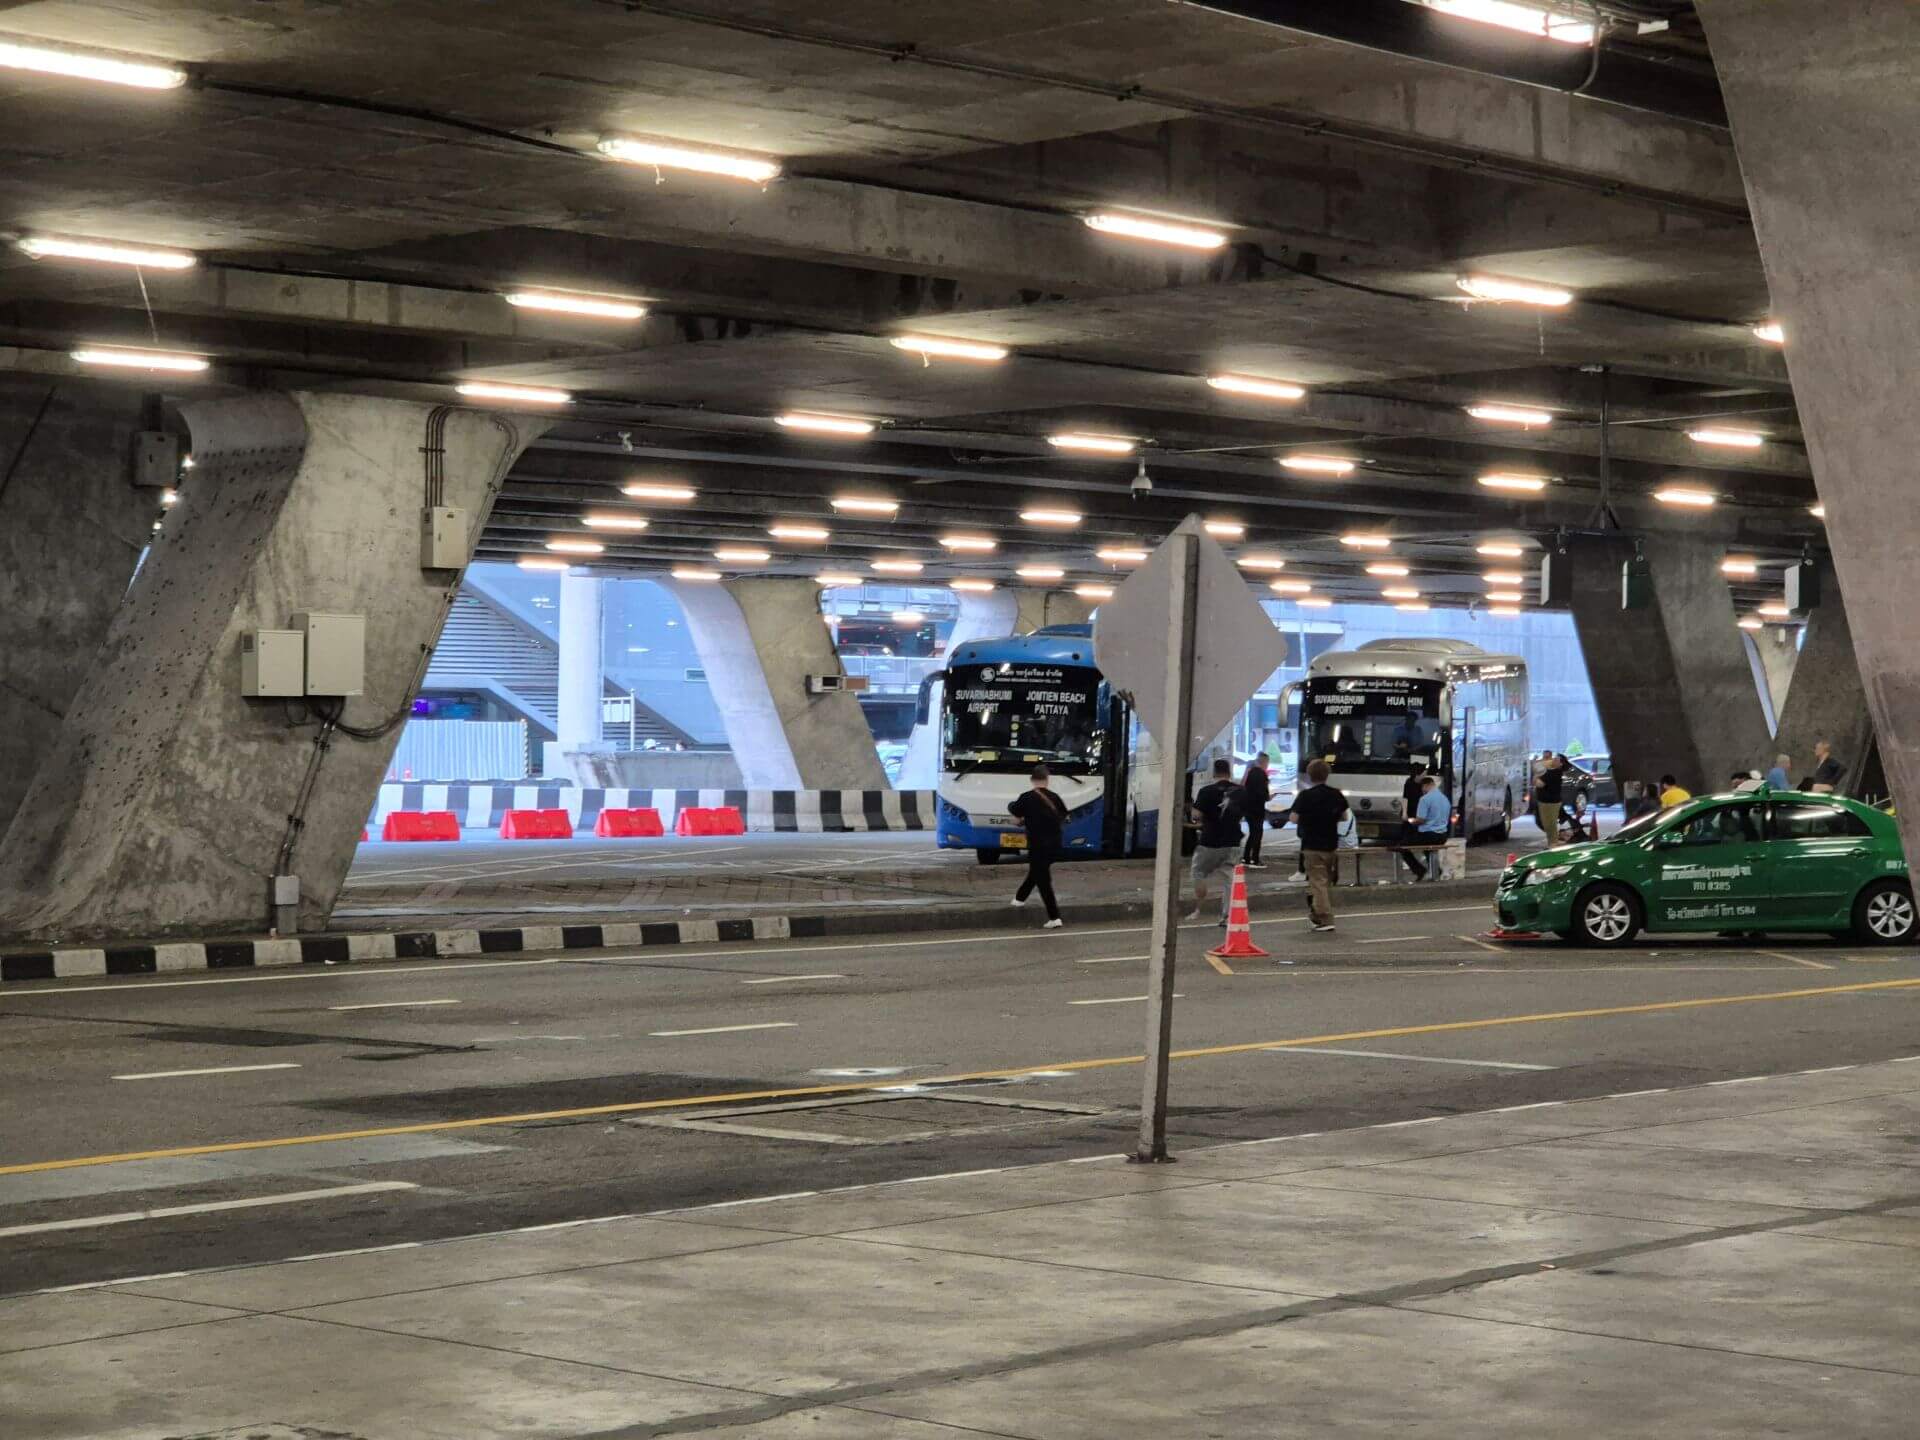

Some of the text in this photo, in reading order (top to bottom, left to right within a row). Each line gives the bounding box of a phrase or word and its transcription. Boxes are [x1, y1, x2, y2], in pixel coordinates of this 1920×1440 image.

[955, 690, 1012, 701] SUVARNABHUMI
[1026, 691, 1086, 704] JOMTIEN BEACH
[1386, 696, 1424, 707] HUA HIN
[967, 702, 1000, 713] AIRPORT
[1034, 704, 1069, 715] PATTAYA
[1324, 705, 1354, 715] AIRPORT
